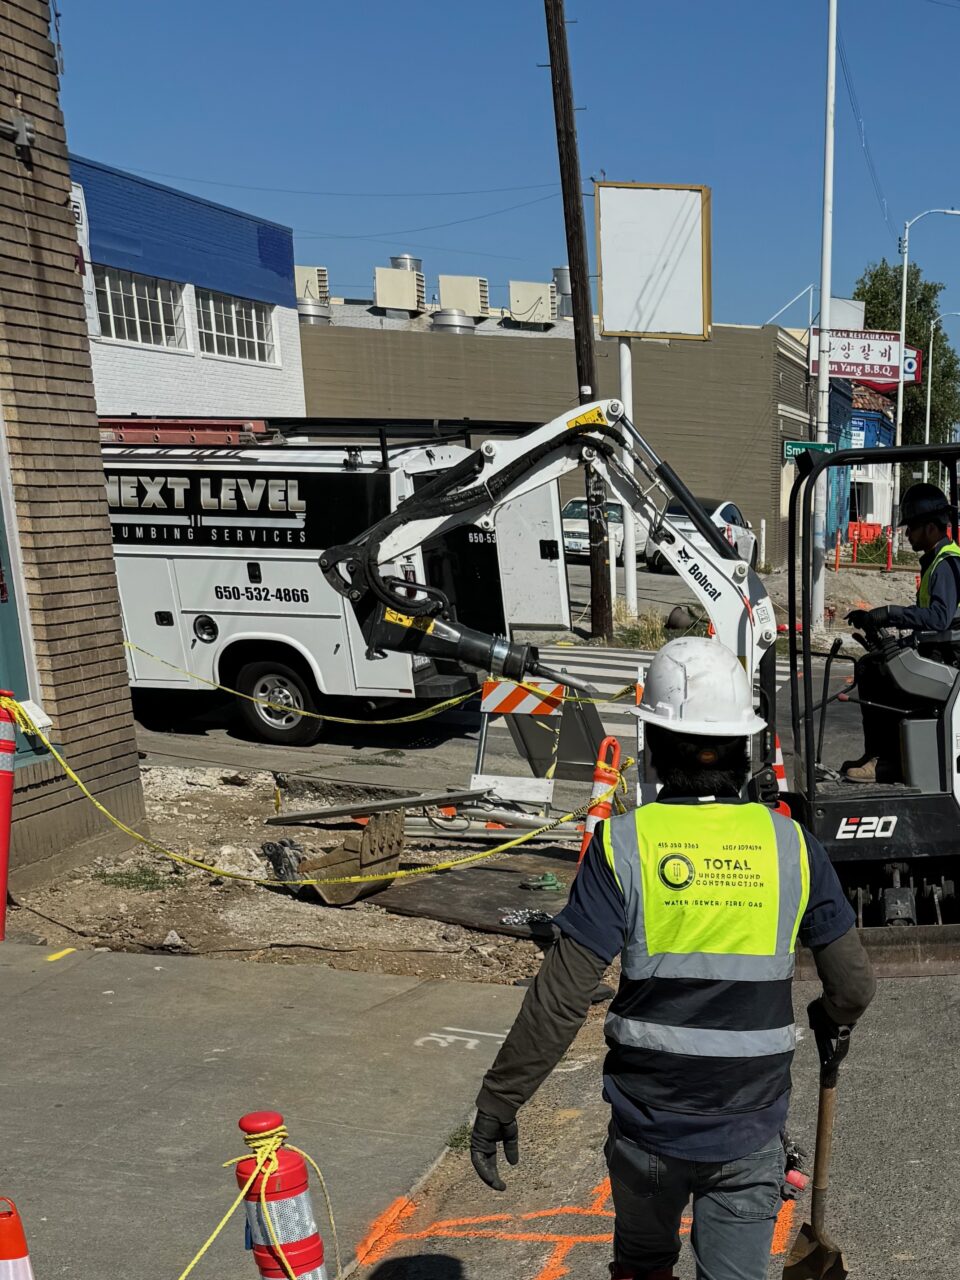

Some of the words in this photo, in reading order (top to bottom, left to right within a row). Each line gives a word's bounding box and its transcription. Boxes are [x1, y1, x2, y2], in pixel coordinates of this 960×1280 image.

[849, 332, 895, 341] RESTAURANT
[841, 363, 862, 376] Yang
[106, 475, 191, 509] NEXT
[200, 478, 307, 511] LEVEL
[111, 526, 194, 540] LUMBING
[211, 528, 306, 543] SERVICES
[688, 563, 722, 602] Bobcat
[214, 585, 310, 603] 650-532-4866
[835, 815, 898, 839] E20
[703, 858, 752, 870] TOTAL
[698, 872, 761, 880] UNDERGROUND
